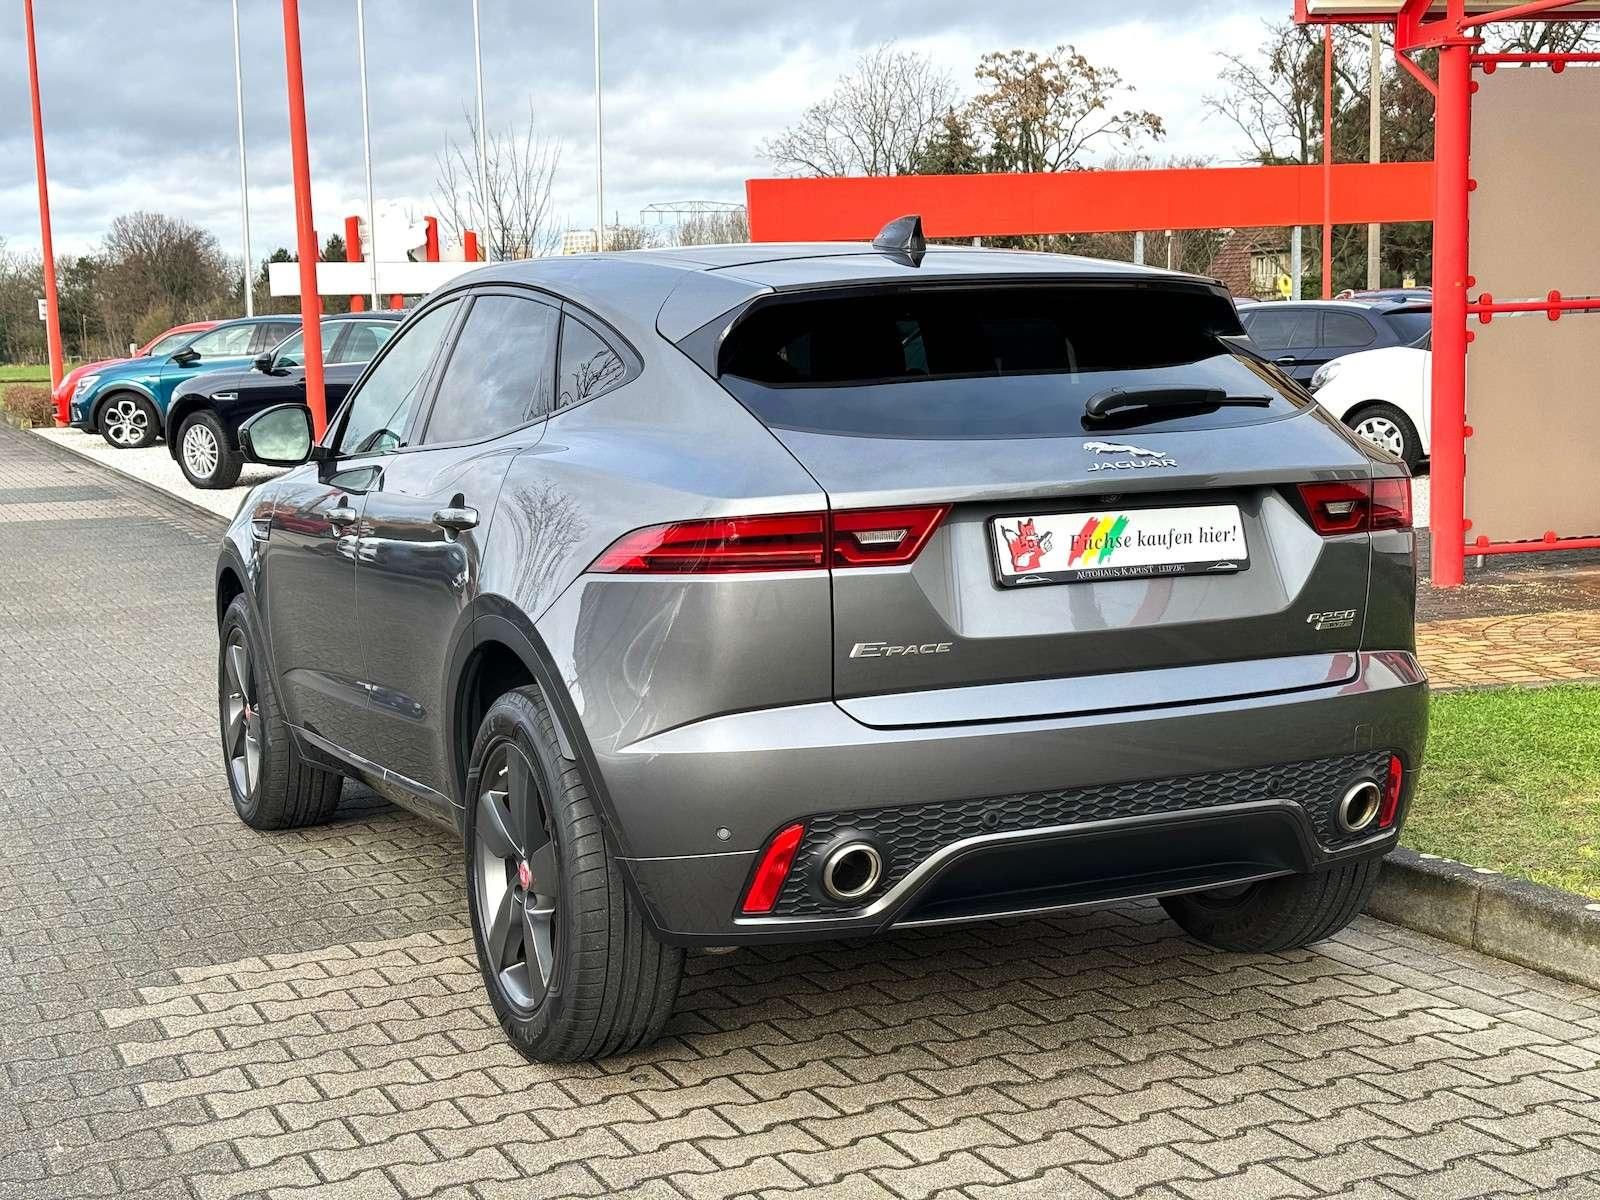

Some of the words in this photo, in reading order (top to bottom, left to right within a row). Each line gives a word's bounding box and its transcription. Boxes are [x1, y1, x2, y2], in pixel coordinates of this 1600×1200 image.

[1087, 459, 1178, 472] JAGUAR
[1070, 531, 1132, 551] Füchse
[1137, 528, 1193, 550] kaufen
[1198, 525, 1237, 543] hier!
[1076, 568, 1120, 579] AUTOHAUS
[1121, 565, 1154, 575] KAPUST
[1158, 565, 1185, 573] LEIPZIG
[1306, 609, 1357, 623] P250
